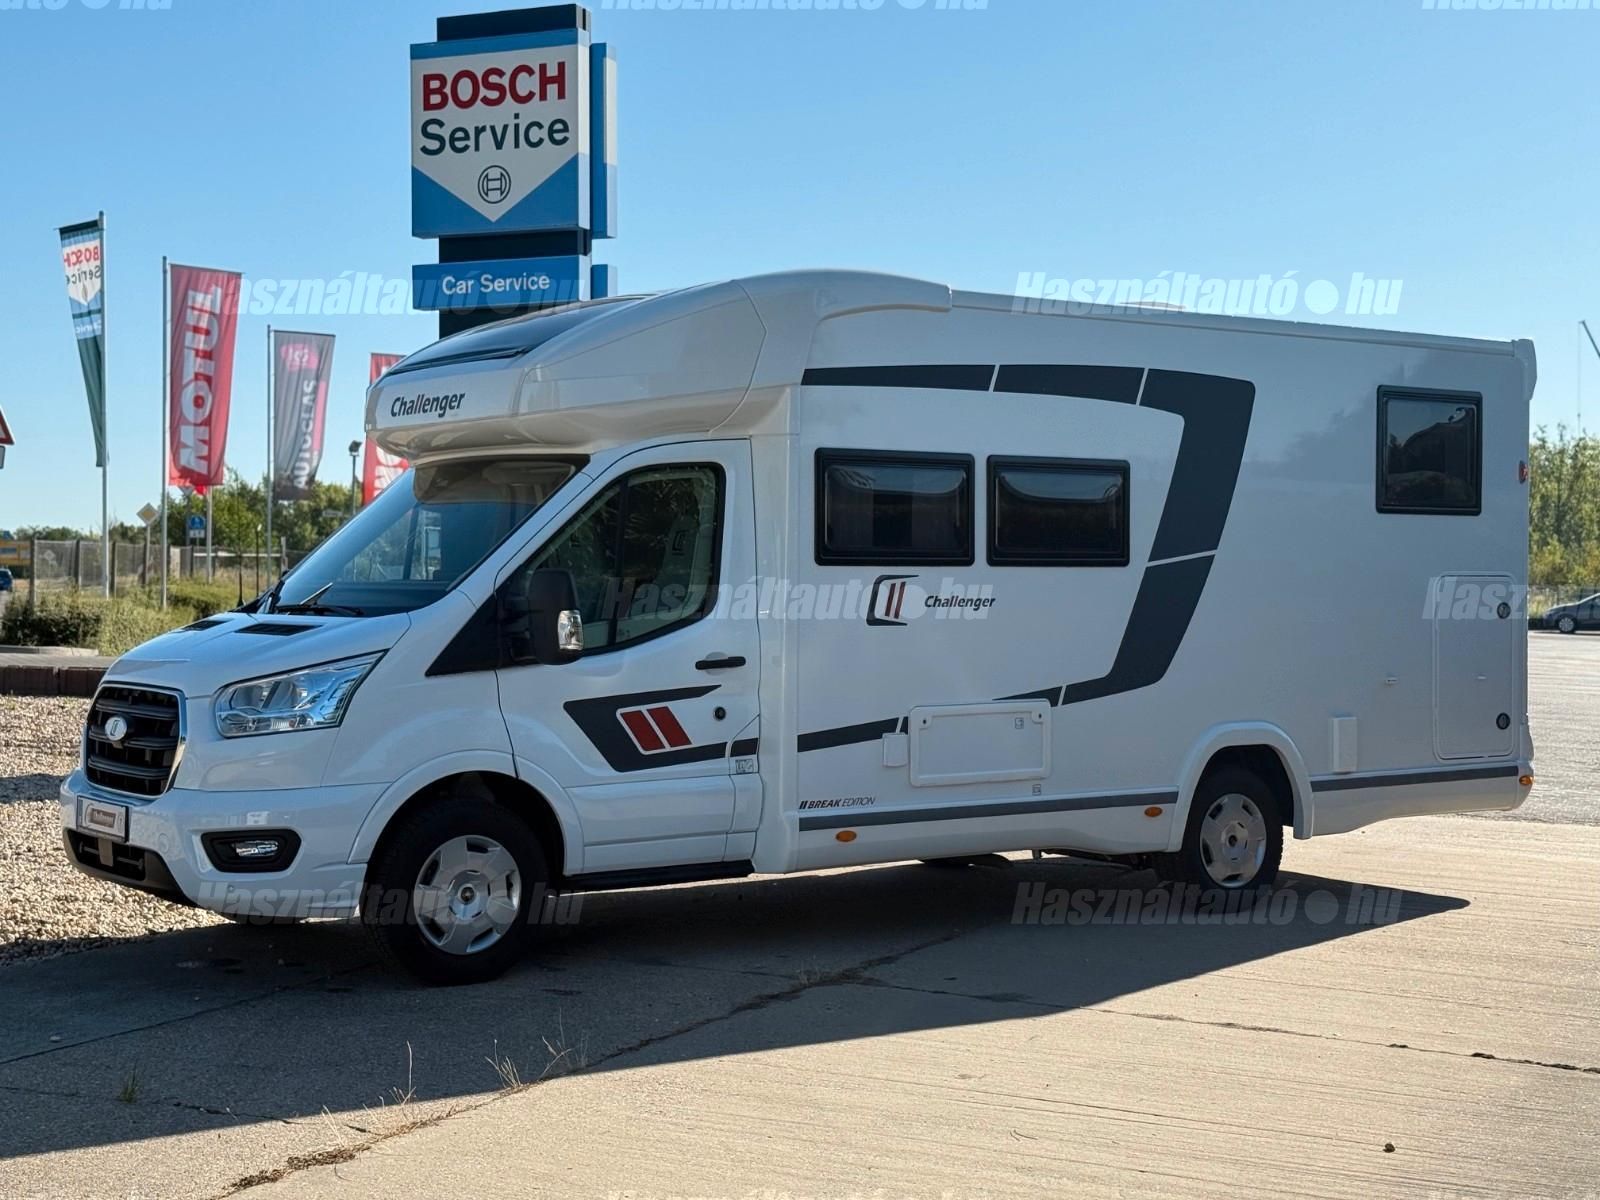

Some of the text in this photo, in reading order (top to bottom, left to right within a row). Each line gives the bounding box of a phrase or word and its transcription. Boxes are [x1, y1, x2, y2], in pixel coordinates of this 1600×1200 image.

[423, 61, 565, 111] BOSCH
[420, 113, 570, 156] Service
[442, 272, 550, 296] Car Service
[178, 284, 222, 475] MOTUL
[391, 392, 466, 418] Challenger
[924, 595, 996, 612] Challenger
[807, 796, 876, 809] BREAK EDITION
